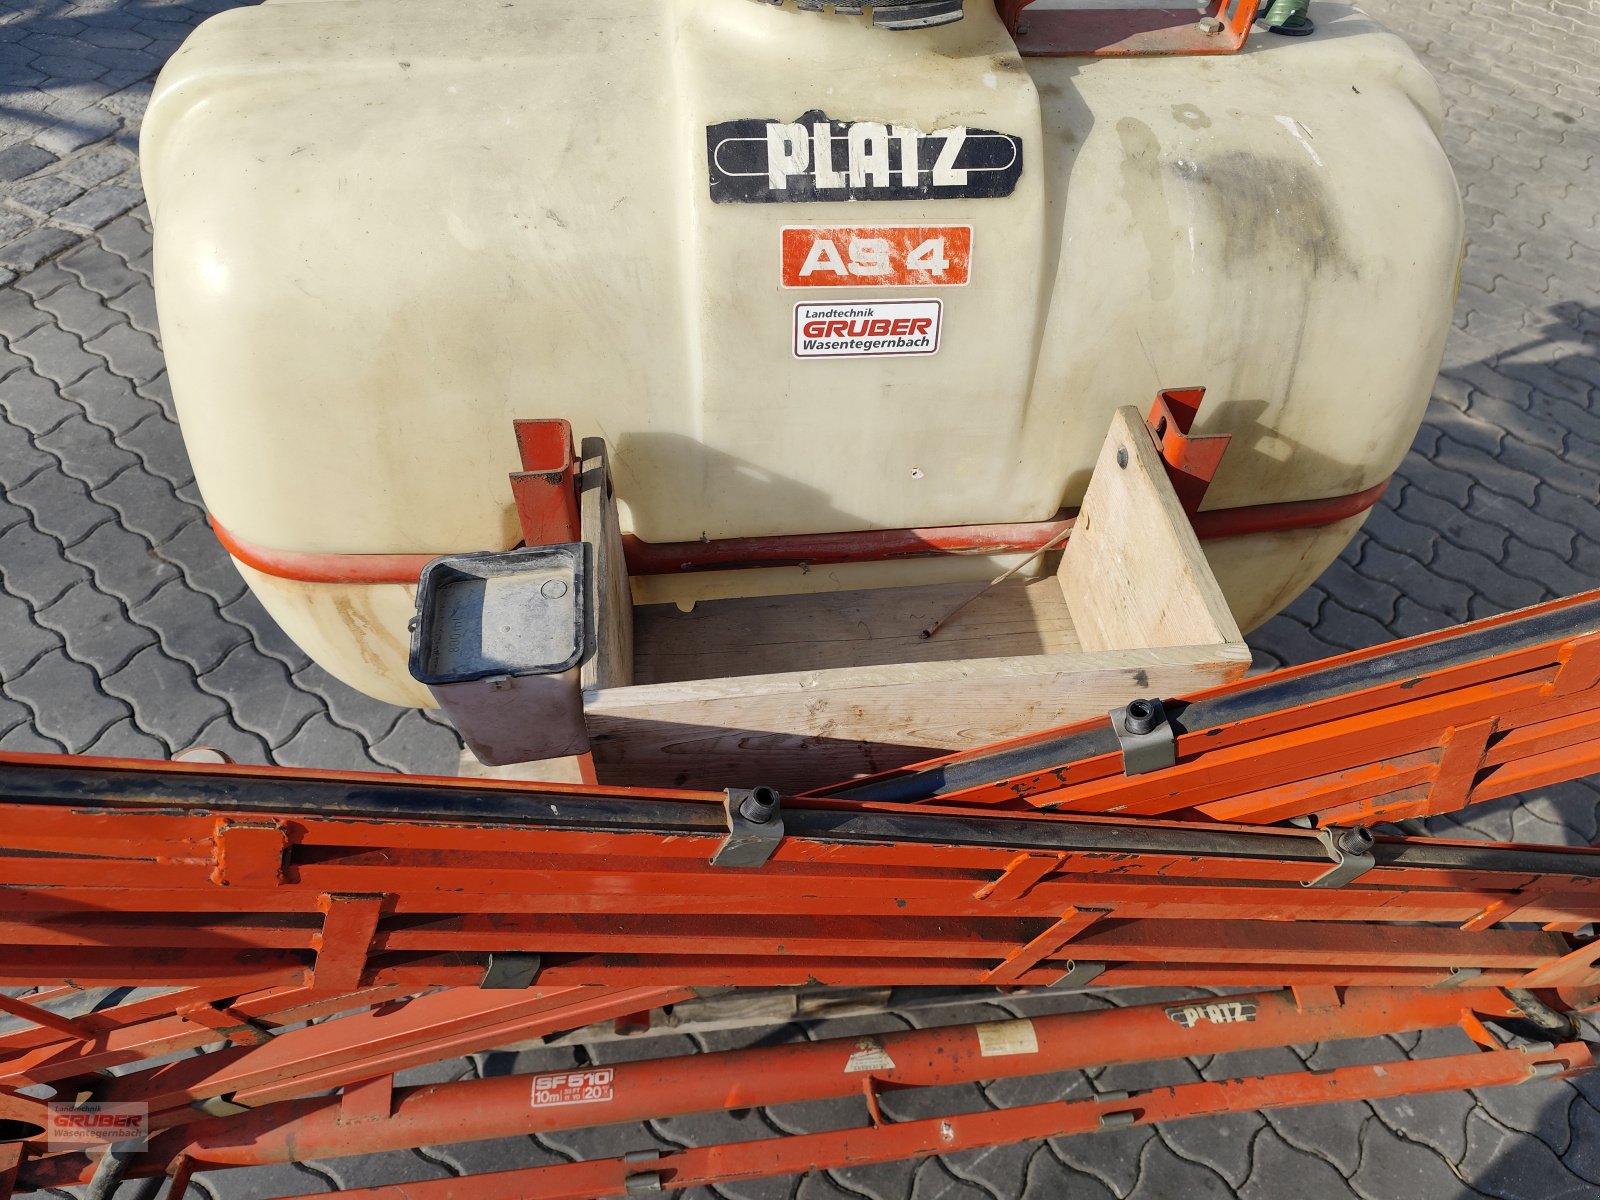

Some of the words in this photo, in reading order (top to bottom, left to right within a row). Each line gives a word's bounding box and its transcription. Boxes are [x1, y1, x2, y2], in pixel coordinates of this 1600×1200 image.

[766, 122, 968, 190] PLATZ
[799, 239, 892, 277] AS
[907, 239, 949, 276] 4
[805, 308, 874, 319] Landtechnik
[803, 318, 932, 338] GRUBER
[803, 337, 930, 351] Wasentegernbach
[536, 1076, 567, 1090] SF
[568, 1072, 609, 1087] 510
[535, 1090, 560, 1104] 10m
[584, 1086, 602, 1099] 20
